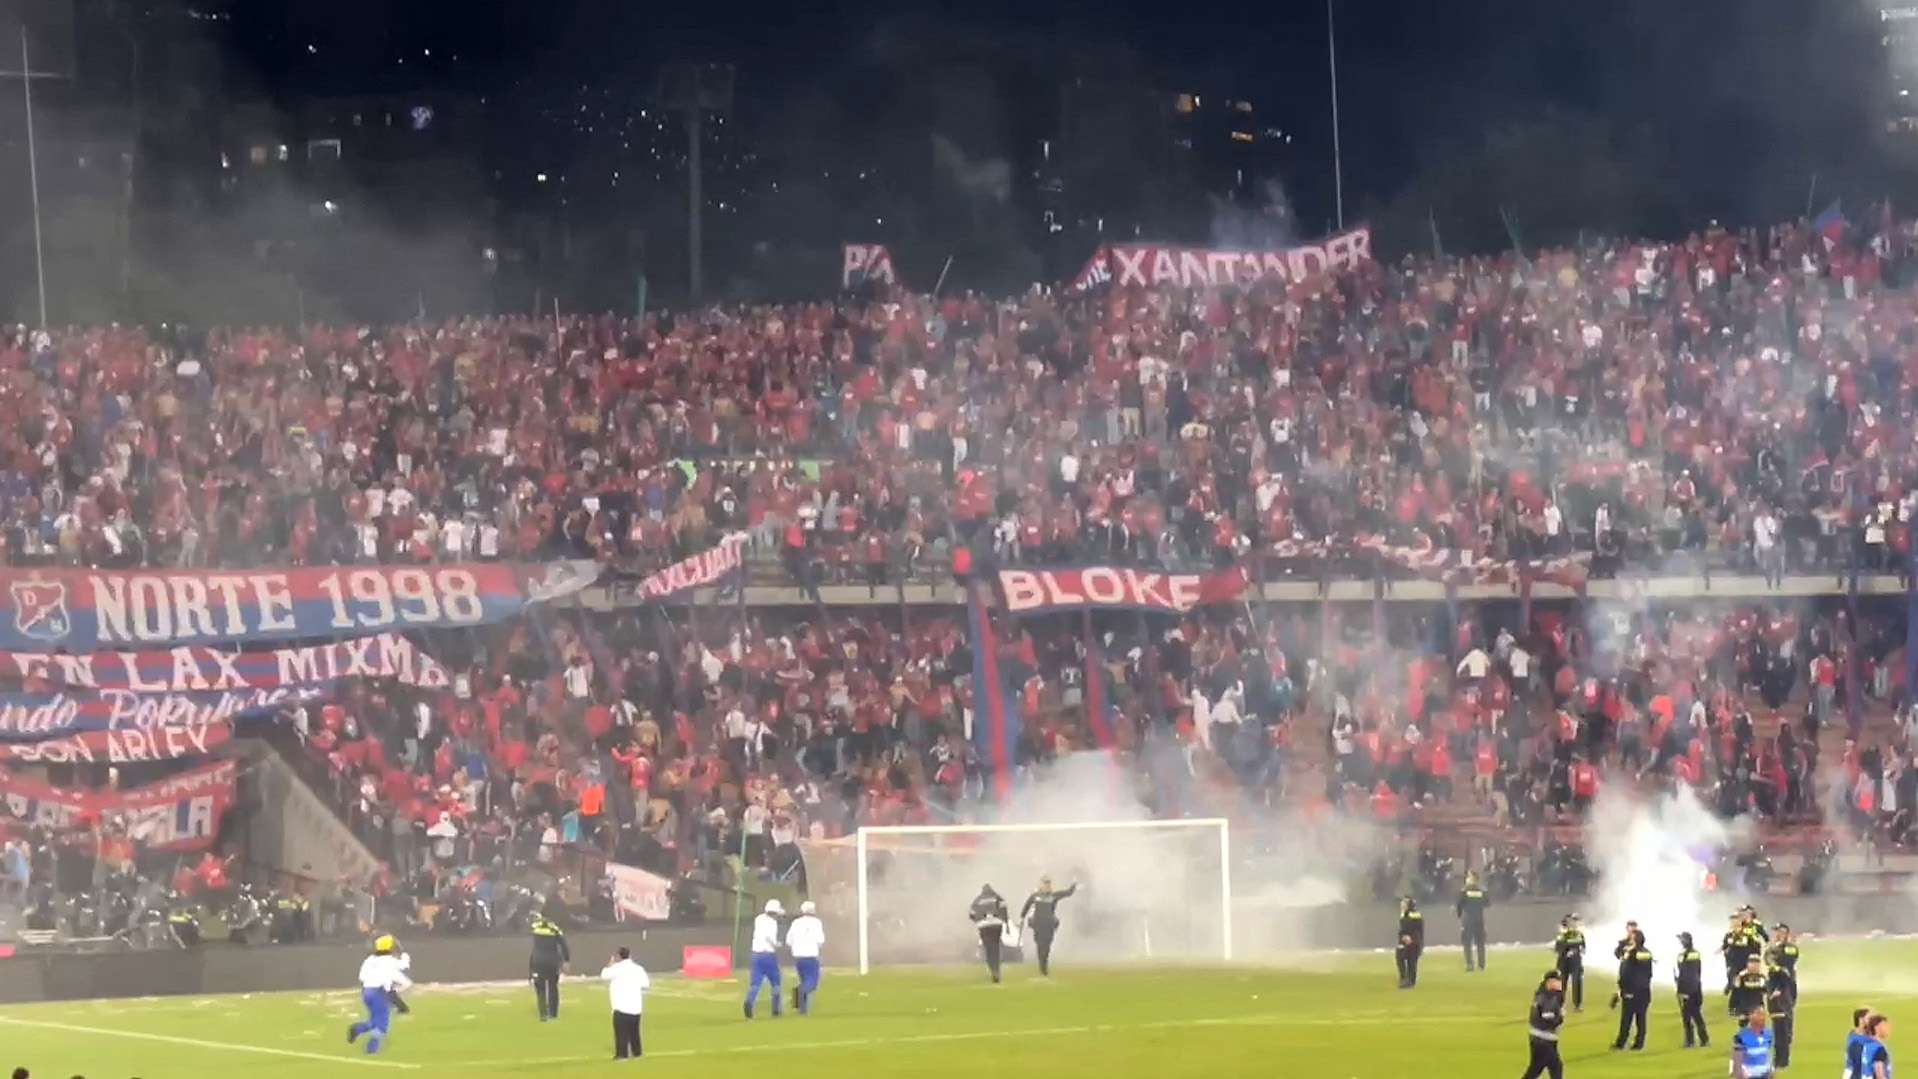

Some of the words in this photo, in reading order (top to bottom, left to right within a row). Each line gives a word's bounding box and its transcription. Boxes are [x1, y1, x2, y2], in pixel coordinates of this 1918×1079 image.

[89, 574, 296, 641] NORTE
[318, 568, 484, 629] 1998
[999, 567, 1200, 611] BLOKE
[116, 643, 252, 691] LAX
